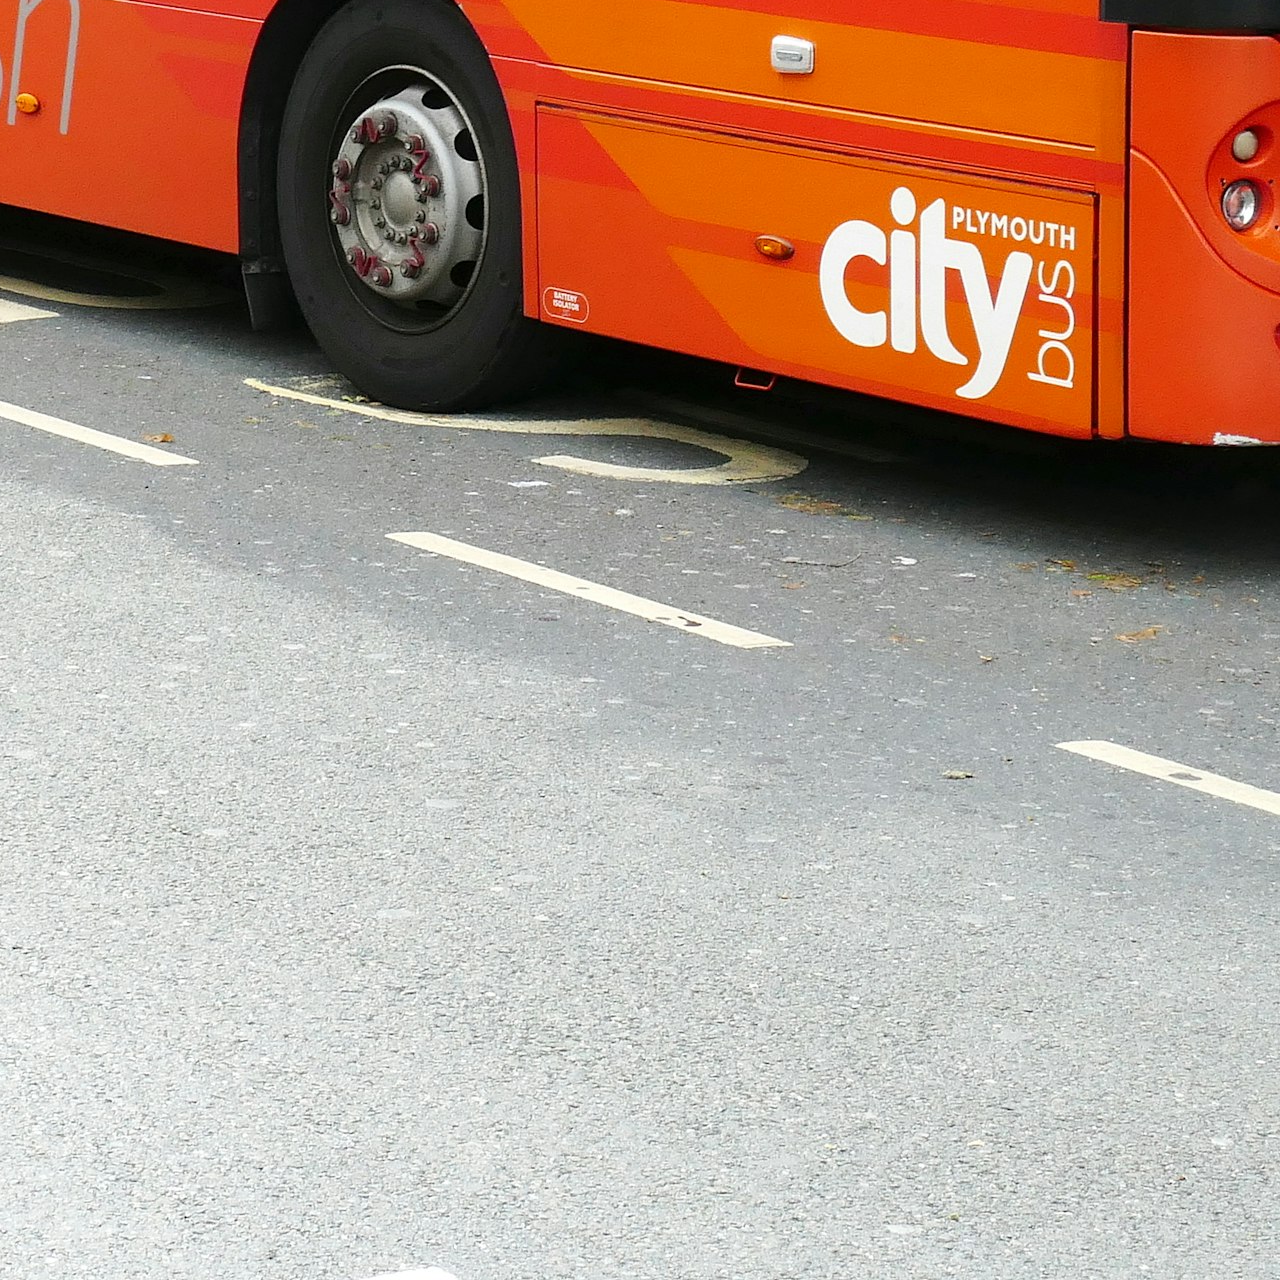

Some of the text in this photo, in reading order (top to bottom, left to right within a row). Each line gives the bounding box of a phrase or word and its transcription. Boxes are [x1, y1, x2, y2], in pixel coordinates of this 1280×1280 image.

[820, 186, 1033, 399] city
[952, 206, 1076, 251] PLYMOUTH
[1027, 260, 1076, 389] bus
